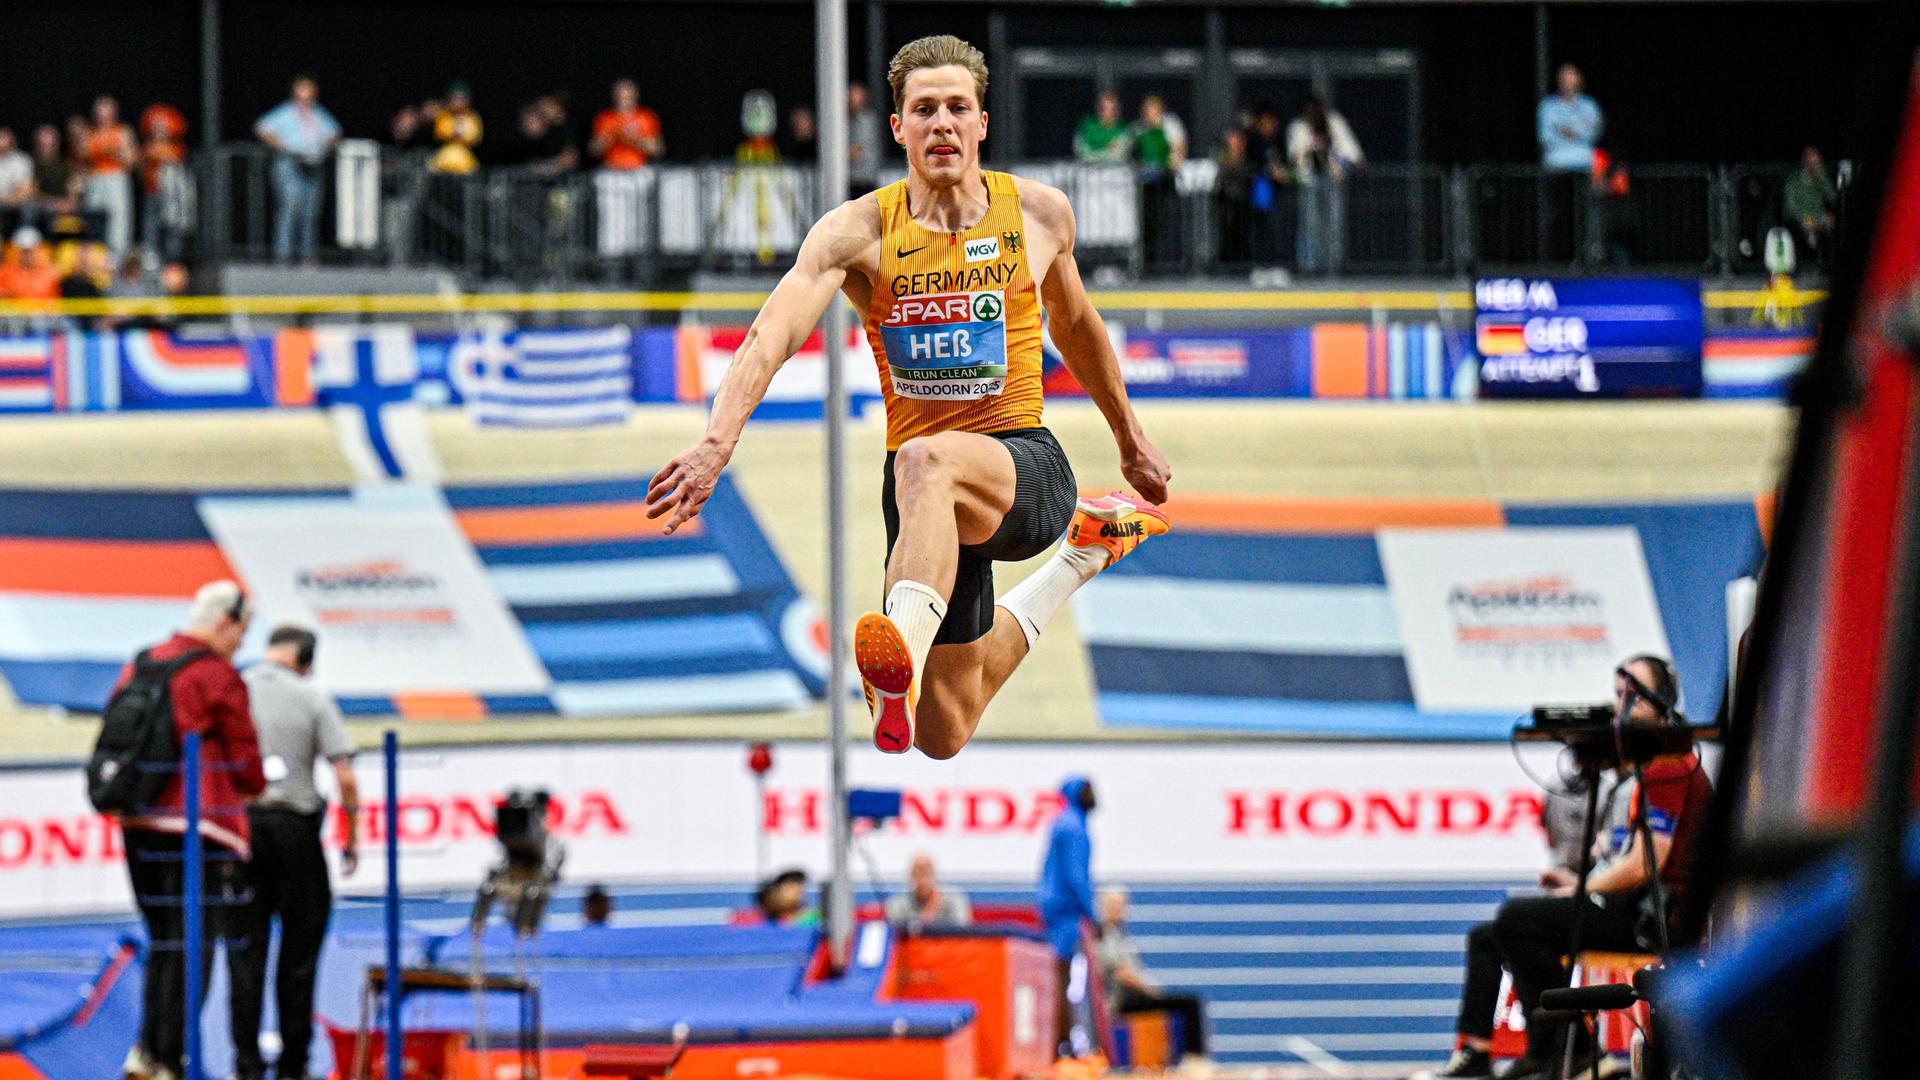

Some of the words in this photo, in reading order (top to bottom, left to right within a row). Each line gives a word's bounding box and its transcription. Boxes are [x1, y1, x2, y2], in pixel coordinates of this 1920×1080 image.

[966, 242, 998, 257] WGV
[891, 262, 1018, 297] GERMANY
[885, 299, 969, 323] SPAR
[910, 329, 973, 360] HEß
[1523, 316, 1588, 352] GER
[896, 381, 971, 395] APELDOORN
[914, 370, 938, 379] RUN
[326, 790, 630, 849] HONA
[761, 788, 1069, 834] HNDA
[1224, 789, 1548, 838] HONDA
